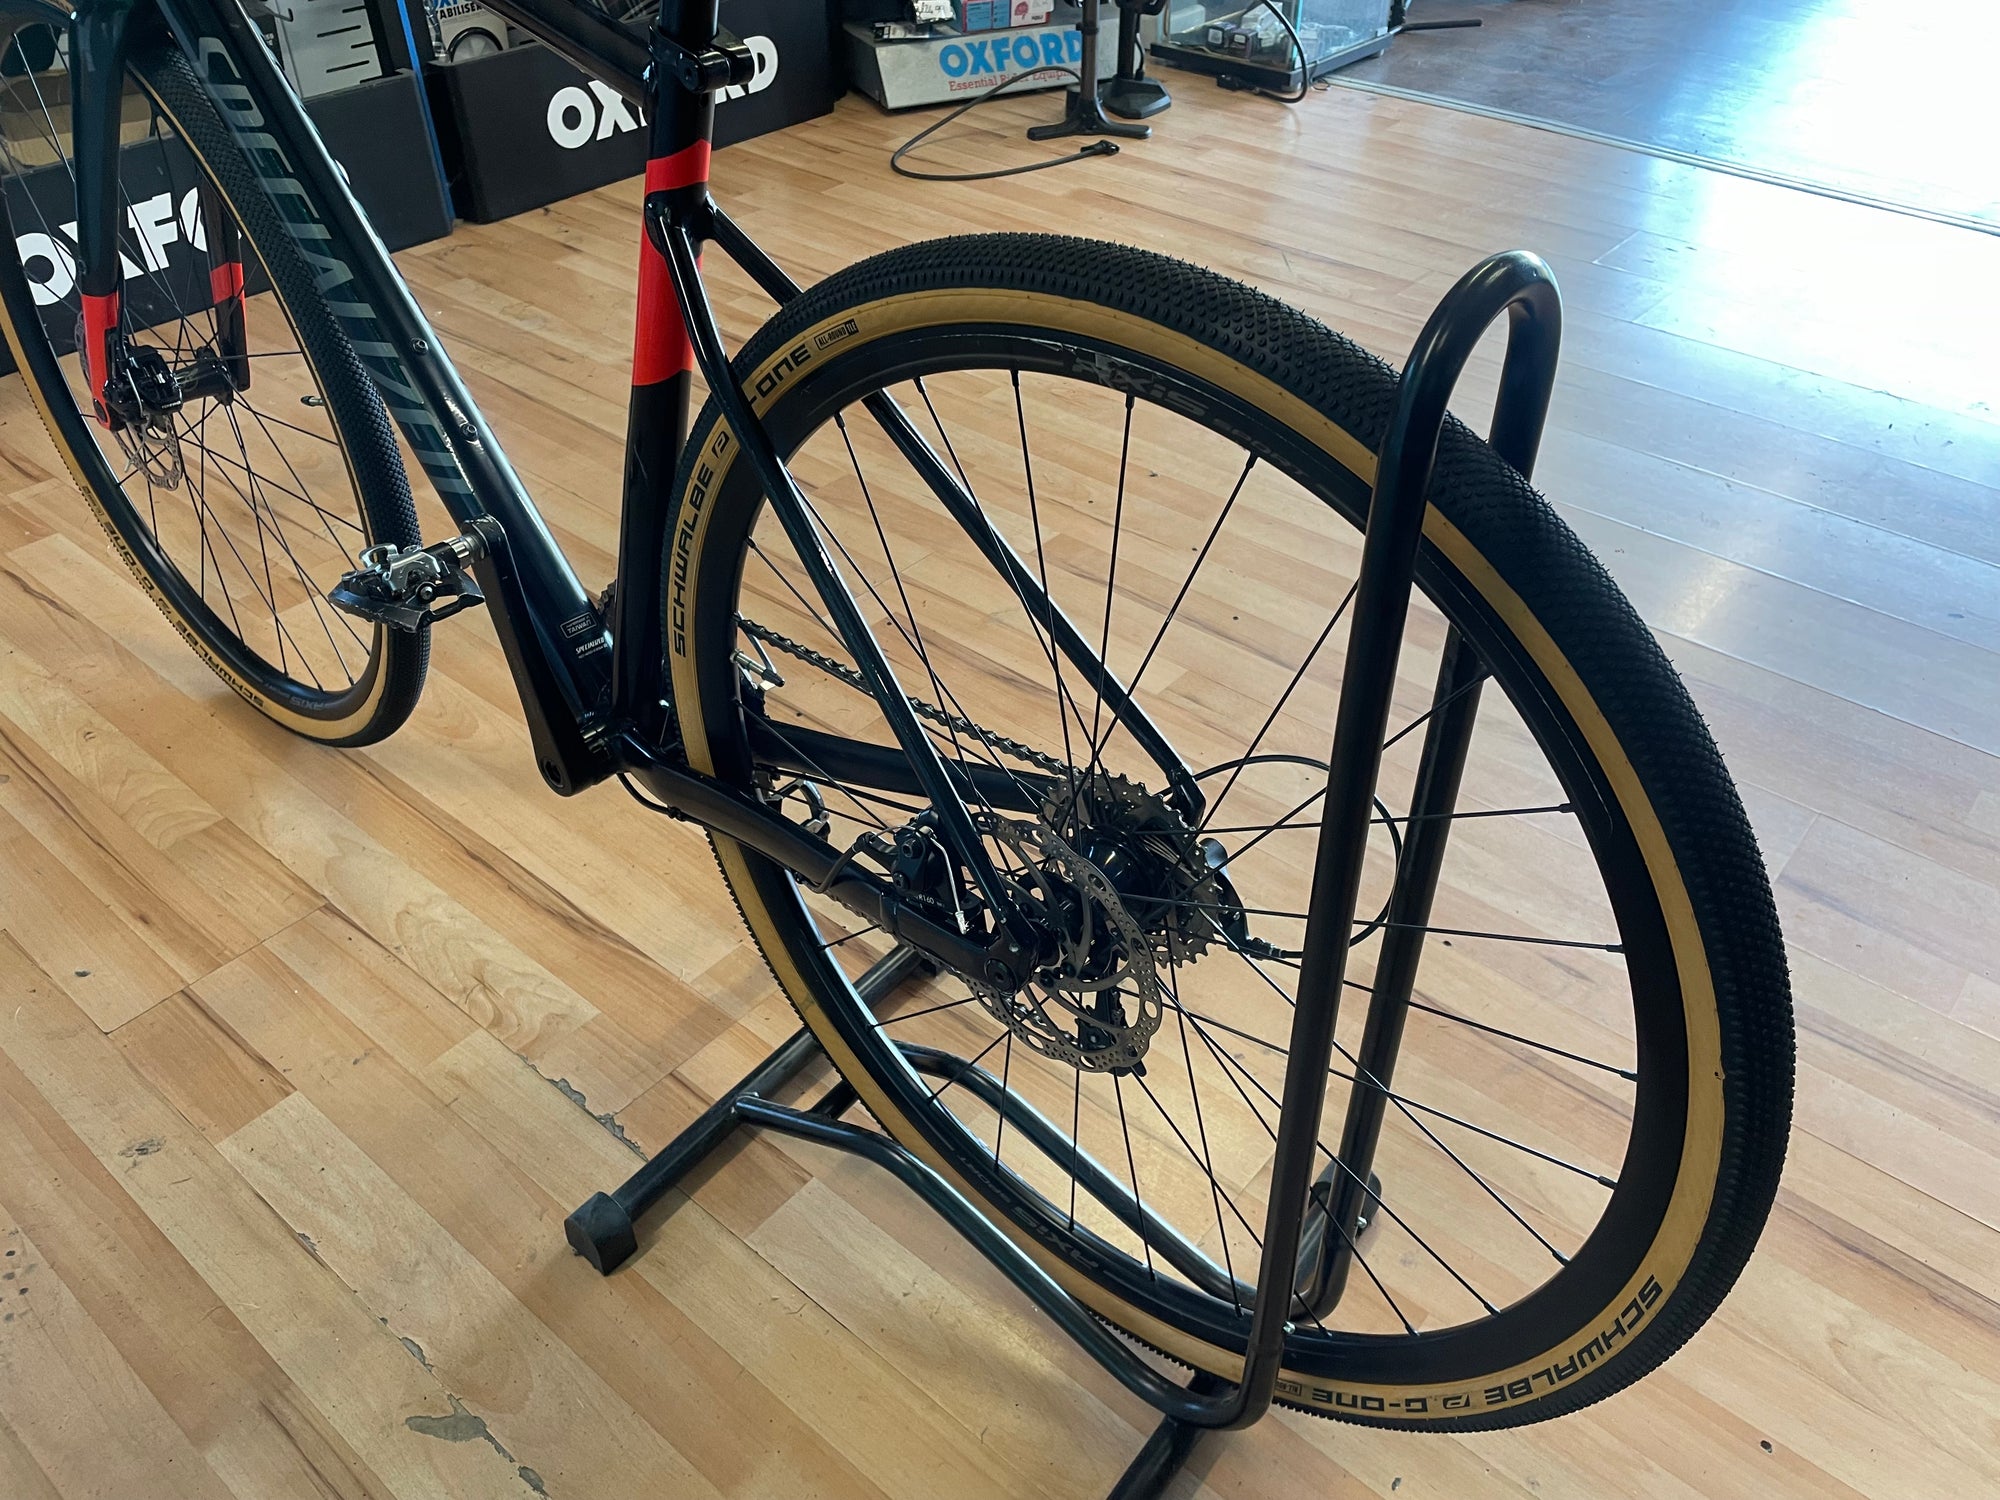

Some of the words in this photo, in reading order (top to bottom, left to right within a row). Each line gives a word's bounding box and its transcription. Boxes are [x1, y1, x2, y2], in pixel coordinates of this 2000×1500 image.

[436, 2, 482, 20] ABILISE
[939, 30, 1083, 78] OXFORD
[546, 35, 778, 149] OXD
[948, 75, 998, 92] Essential
[673, 461, 714, 659] SCHWALBE
[748, 343, 813, 405] -ONE
[567, 619, 592, 634] TAIWAN
[175, 620, 265, 708] SCHWALBE
[1484, 1274, 1664, 1406] SCHWALBE
[1311, 1387, 1429, 1414] G-ONE
